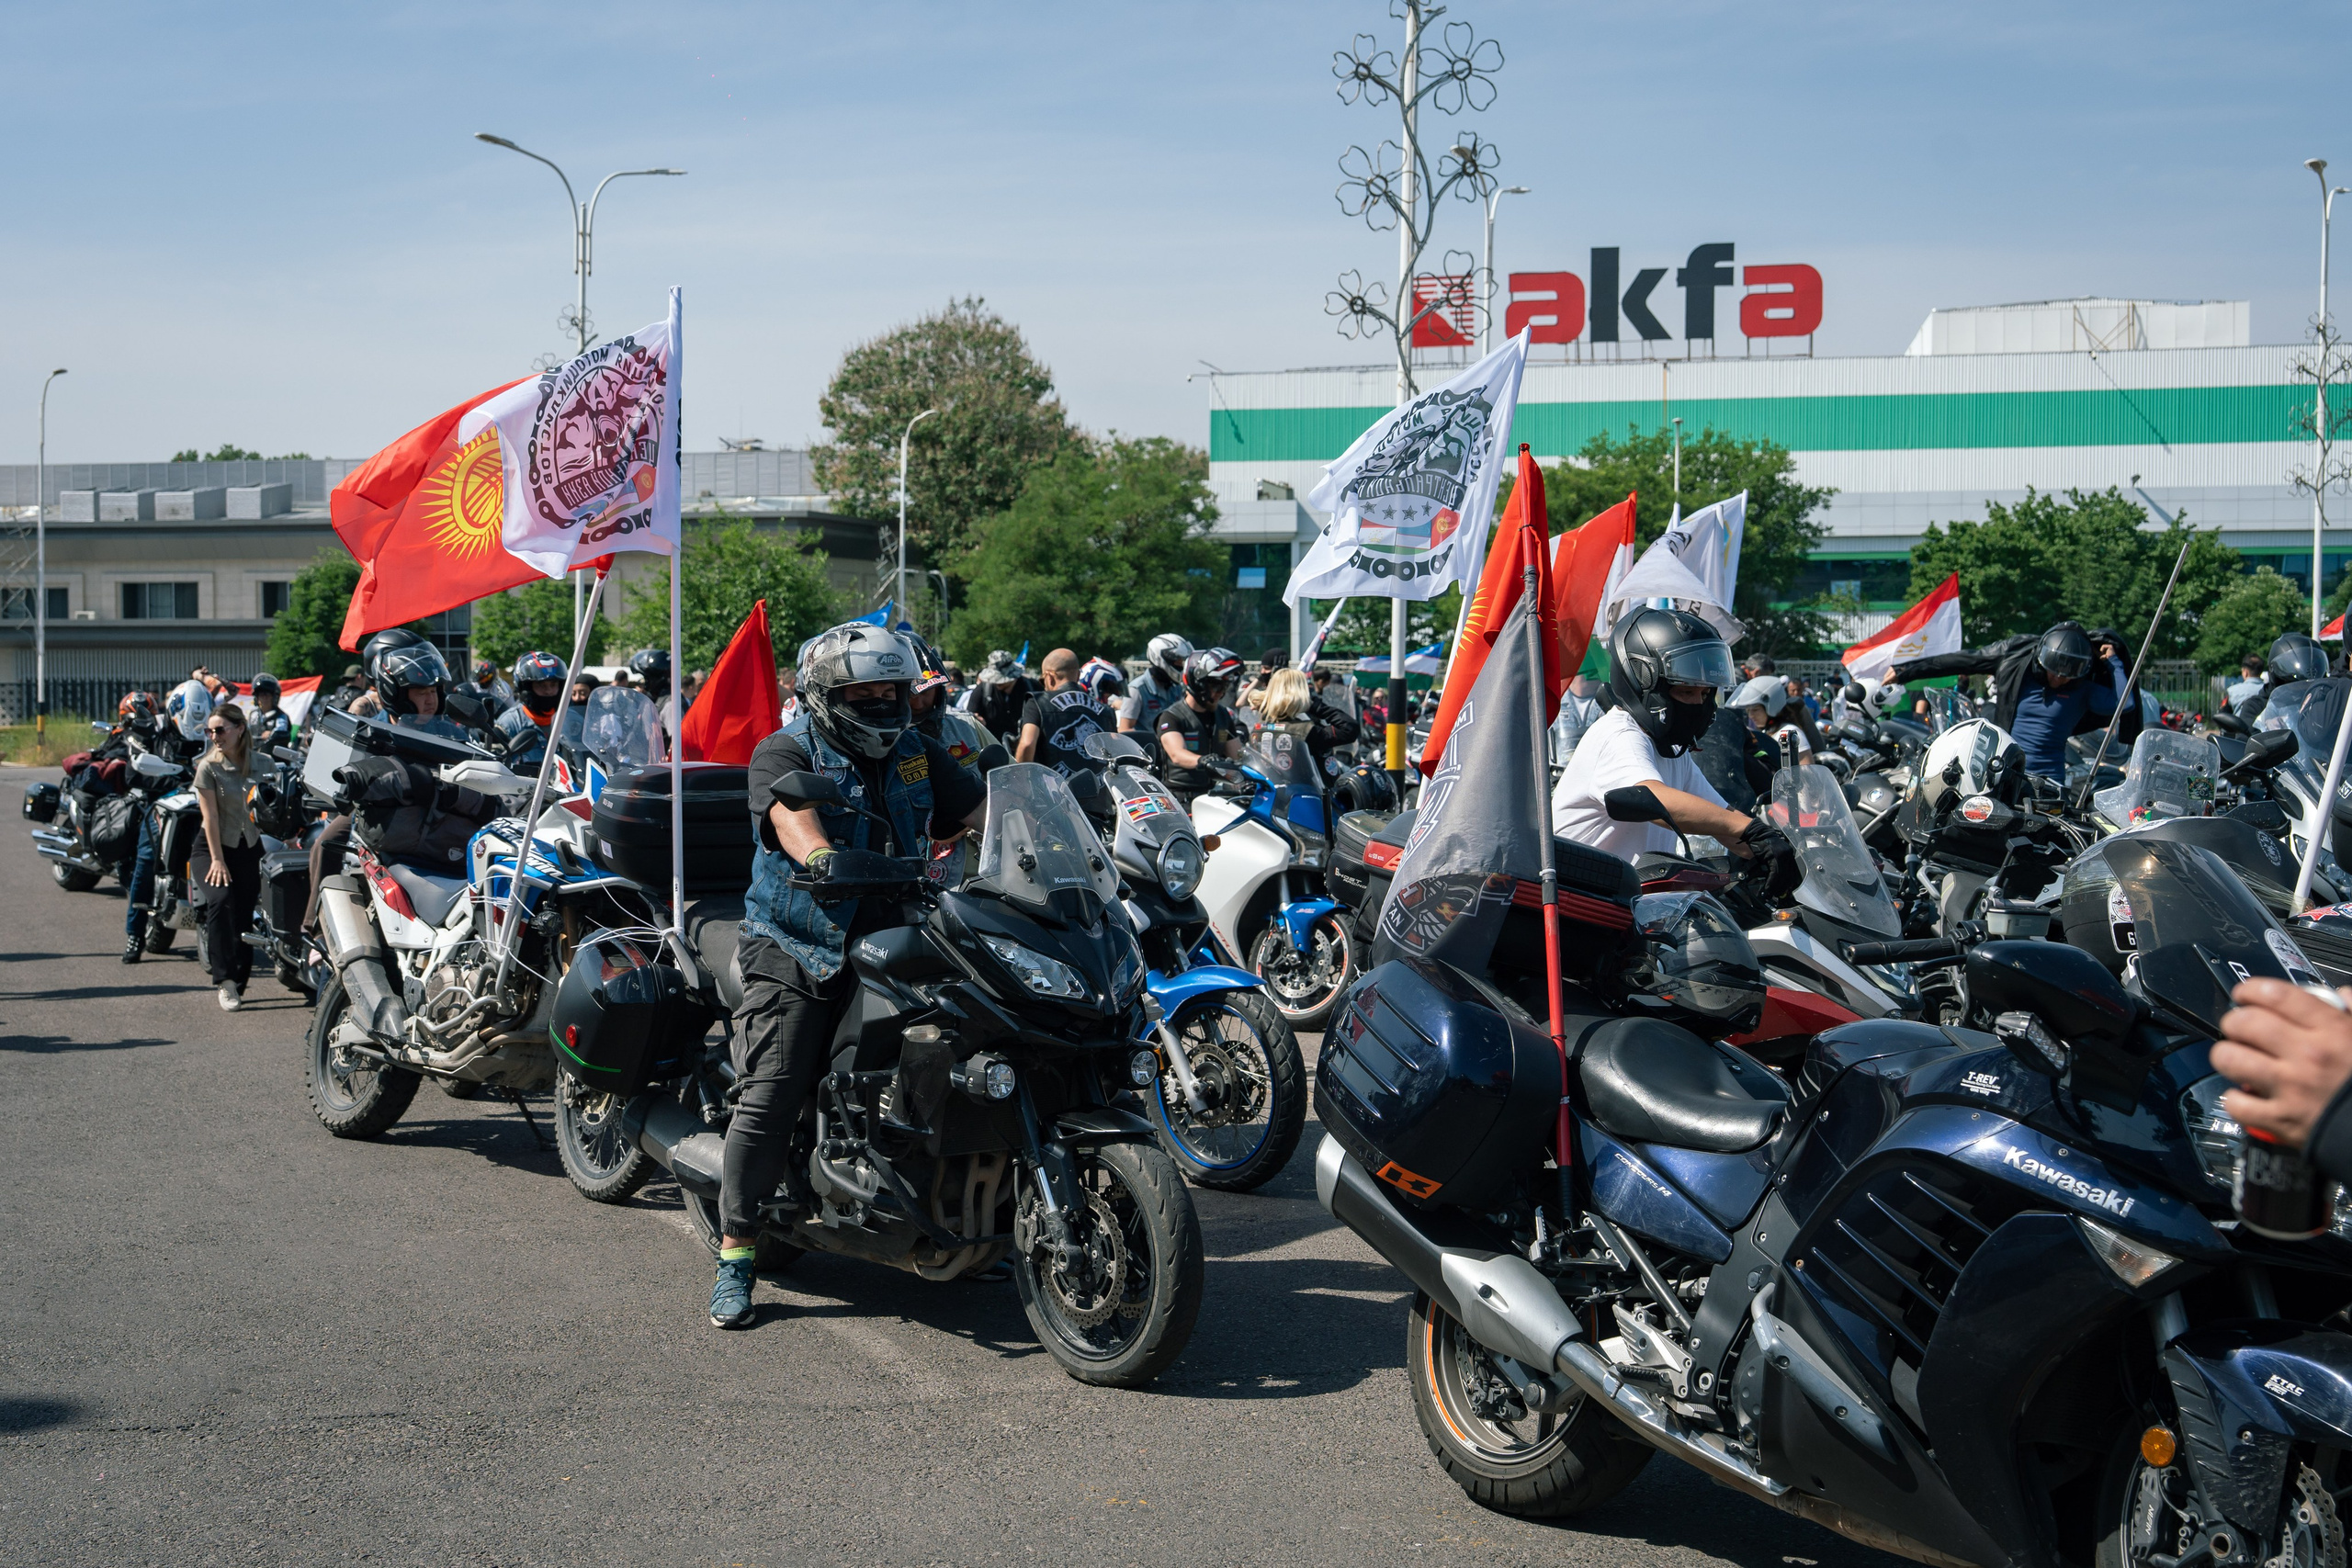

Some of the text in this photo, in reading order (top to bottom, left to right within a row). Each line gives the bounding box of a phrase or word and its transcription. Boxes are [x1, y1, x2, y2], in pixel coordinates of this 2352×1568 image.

[1505, 242, 1824, 344] akfa
[859, 938, 889, 960] Kawasaki
[1967, 1071, 1997, 1085] T-REV
[2003, 1145, 2135, 1218] Kawasaki
[2270, 1374, 2305, 1395] KTRC
